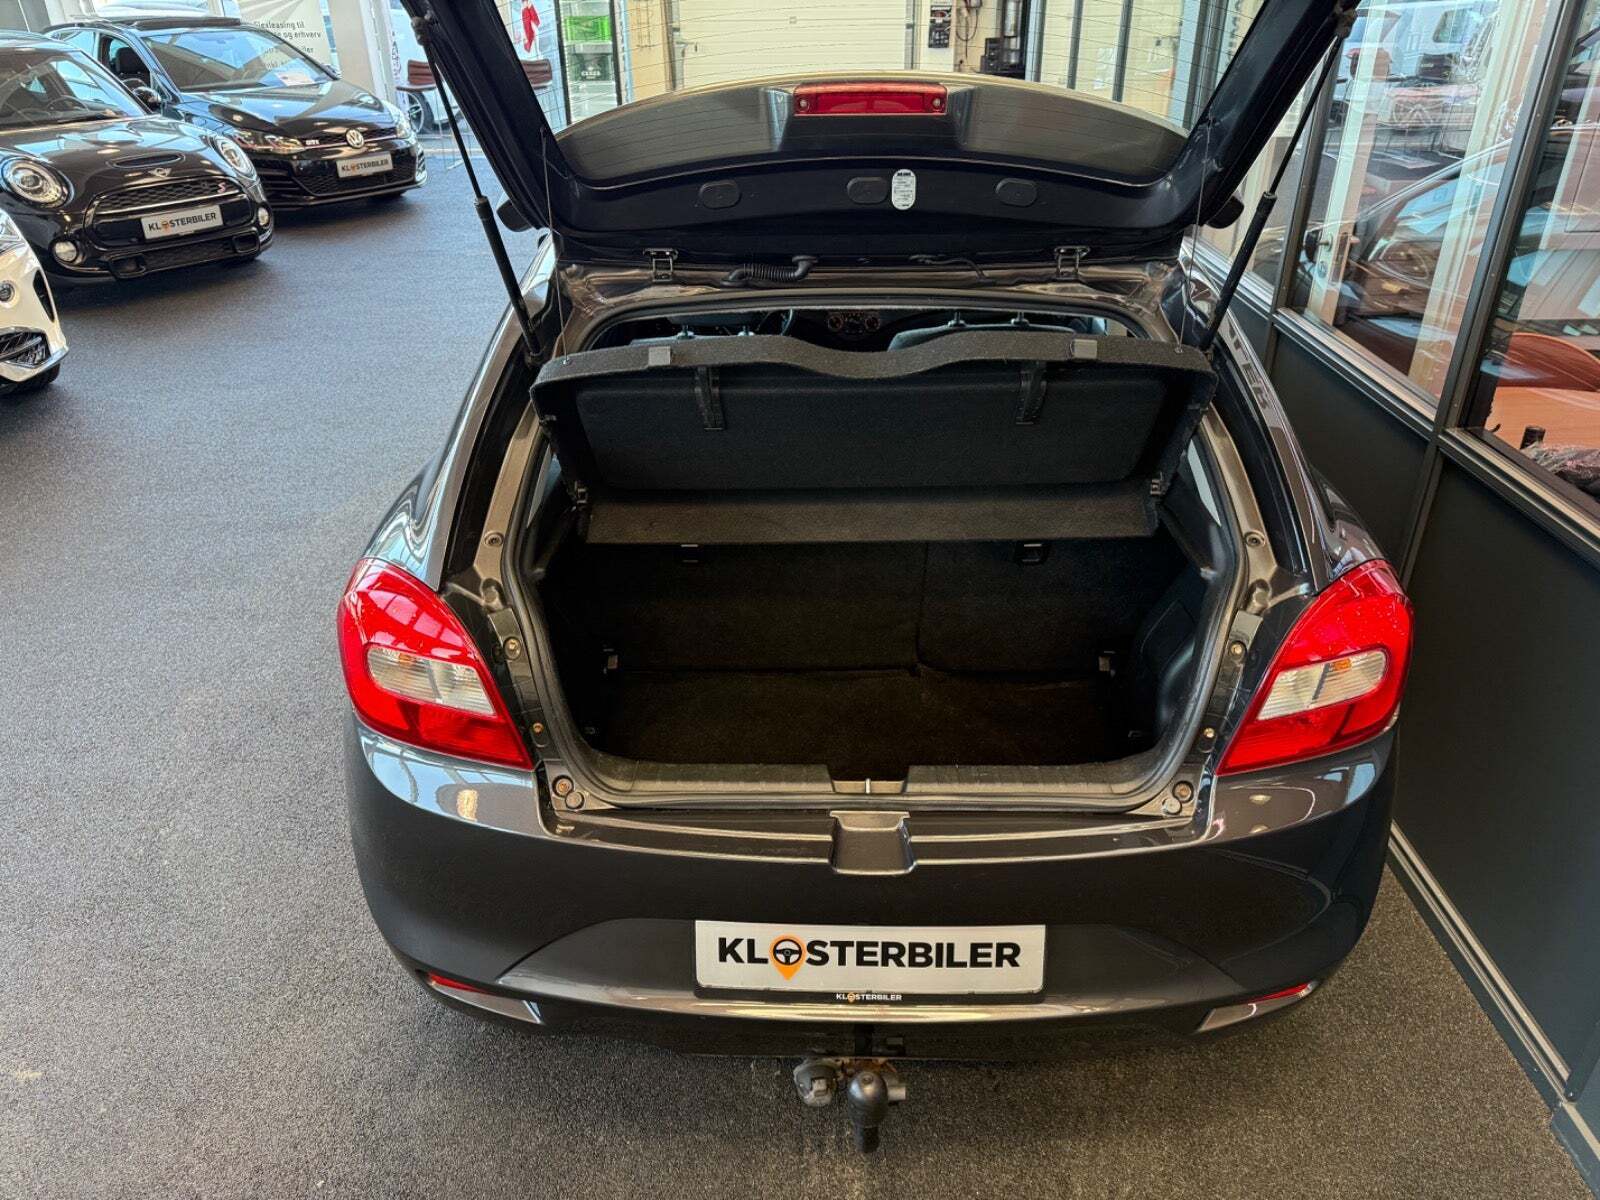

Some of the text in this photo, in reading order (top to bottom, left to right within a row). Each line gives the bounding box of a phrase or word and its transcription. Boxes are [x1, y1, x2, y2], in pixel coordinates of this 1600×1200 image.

[148, 212, 217, 232] KLOSTERBILER
[718, 936, 1021, 974] KLOSTERBILER
[836, 993, 902, 1002] KLOSTERBILER
